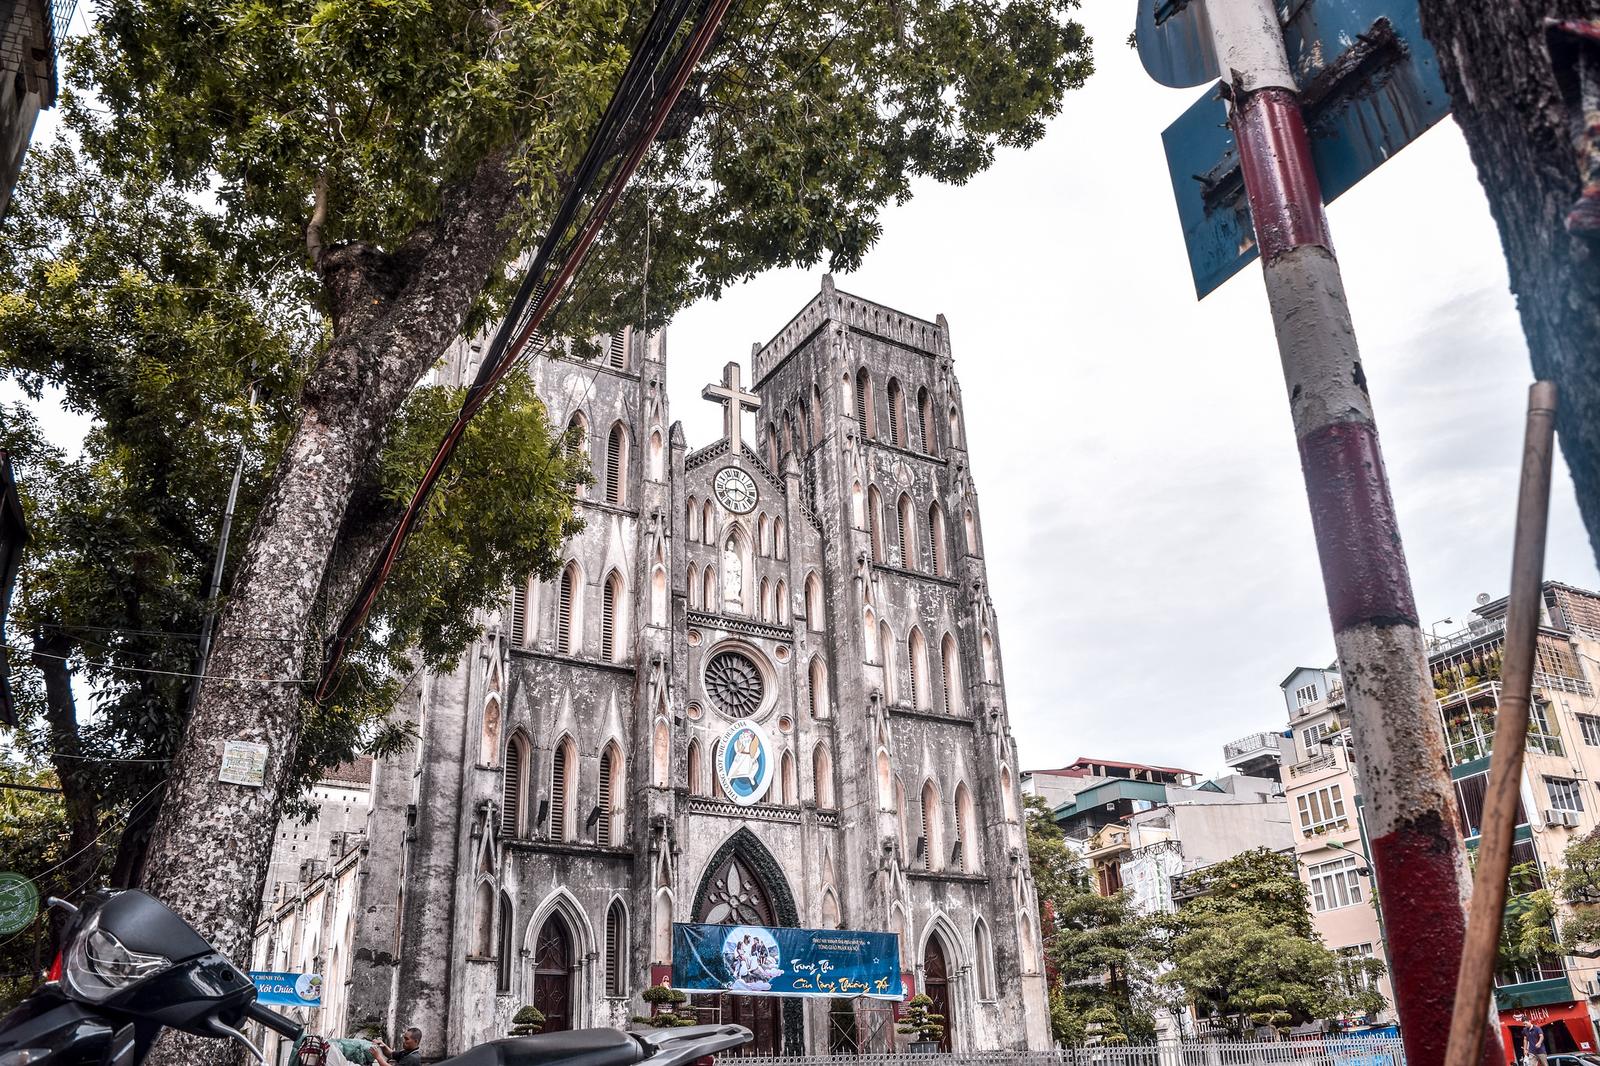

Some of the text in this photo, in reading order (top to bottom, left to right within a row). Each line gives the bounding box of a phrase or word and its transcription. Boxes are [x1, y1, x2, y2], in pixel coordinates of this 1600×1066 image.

[791, 959, 834, 975] Trung Thu
[257, 984, 294, 994] Xót Chúa
